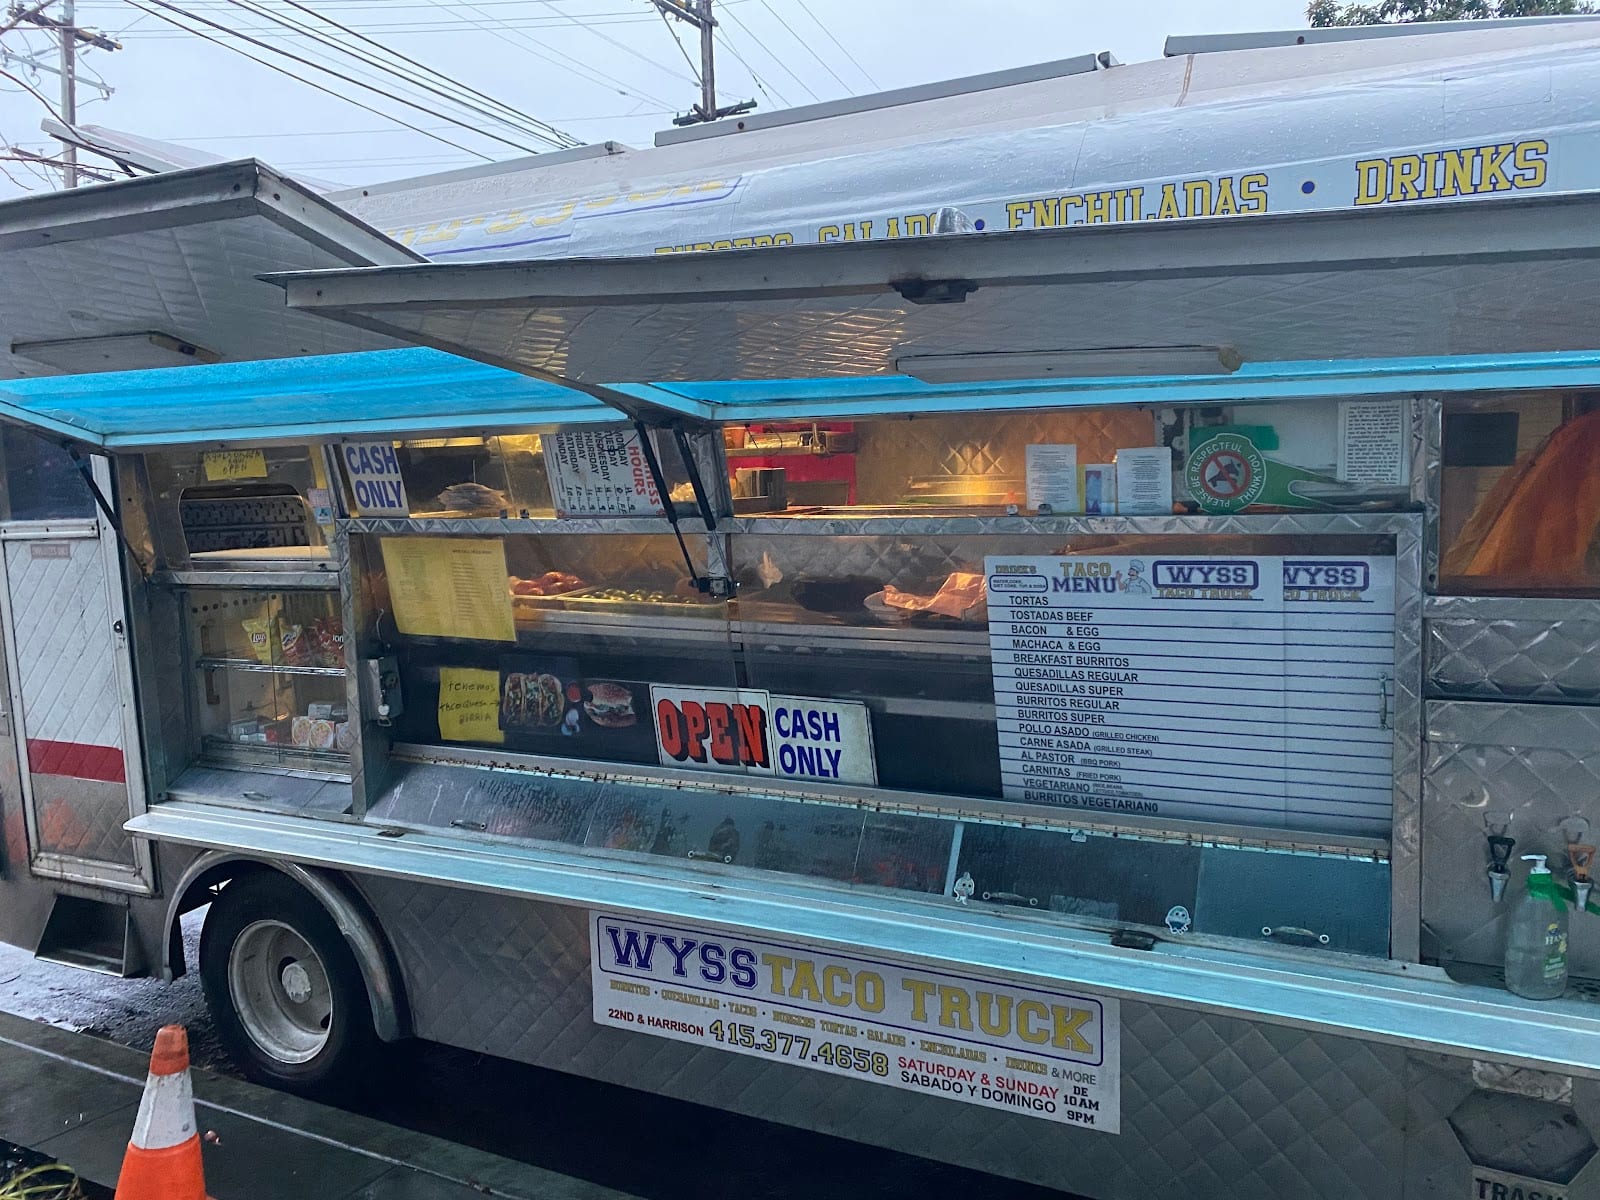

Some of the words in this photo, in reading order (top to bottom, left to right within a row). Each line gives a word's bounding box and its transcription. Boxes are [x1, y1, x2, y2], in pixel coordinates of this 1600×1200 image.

[1006, 173, 1268, 228] ENCHILADAS
[1355, 140, 1549, 206] DRINKS
[345, 446, 399, 475] CASH
[1191, 441, 1242, 473] RESPECTFUL
[1248, 454, 1261, 474] YOU
[628, 446, 646, 496] HOURS
[1191, 475, 1201, 487] BE
[1238, 475, 1262, 504] THANK
[355, 479, 403, 508] ONLY
[1195, 488, 1230, 507] PLEASE
[1060, 562, 1112, 577] TACO
[1166, 566, 1248, 584] WYSS
[1052, 576, 1118, 593] MENU
[1200, 588, 1253, 599] TRUCK
[1009, 595, 1049, 606] TORTAS
[1010, 610, 1063, 621] TOSTADAS
[1066, 611, 1094, 622] BEEF
[1011, 625, 1047, 635] BACON
[1066, 627, 1073, 636] &
[1076, 626, 1099, 637] EGG
[1012, 639, 1063, 650] MACHACA
[1068, 641, 1075, 650] &
[1078, 641, 1101, 651] EGG
[1013, 653, 1073, 665] BREAKFAST
[1076, 656, 1129, 667] BURRITOS
[1014, 667, 1085, 680] QUESADILLAS
[1087, 671, 1138, 682] REGULAR
[1015, 682, 1086, 694] QUESADILLAS
[1088, 685, 1124, 696] SUPER
[1016, 696, 1067, 707] BURRITOS
[1070, 699, 1120, 711] REGULAR
[775, 707, 841, 743] CASH
[1017, 709, 1068, 721] BURRITOS
[1070, 712, 1105, 724] SUPER
[657, 699, 770, 768] OPEN
[1019, 723, 1052, 734] POLLO
[1054, 725, 1090, 737] ASADO
[1092, 731, 1124, 740] (GRILLED
[1125, 733, 1160, 742] CHICKEN)
[1020, 737, 1054, 748] CARNE
[1056, 739, 1091, 751] ASADA
[1093, 745, 1125, 754] (GRILLED
[1127, 747, 1153, 757] STEAK)
[779, 743, 842, 778] ONLY
[1021, 751, 1034, 760] AL
[1037, 752, 1075, 764] PASTOR
[1099, 759, 1121, 768] PORK)
[1022, 764, 1071, 777] CARNITAS
[1099, 773, 1122, 783] PORK)
[1023, 778, 1090, 792] VEGETARIANO
[1024, 791, 1079, 805] BURRITOS
[605, 925, 758, 990] WYSS
[762, 952, 885, 1014] TACO
[902, 978, 1094, 1054] TRUCK
[608, 1008, 634, 1023] 22ND
[637, 1014, 645, 1025] &
[647, 1016, 704, 1037] HARRISON
[709, 1019, 889, 1077] 415.377.4658
[898, 1056, 976, 1083] SATURDAY
[980, 1073, 991, 1086] &
[995, 1076, 1059, 1101] SUNDAY
[1051, 1066, 1060, 1078] &
[1062, 1069, 1097, 1085] MORE
[901, 1071, 963, 1094] SABADO
[967, 1084, 978, 1097] Y
[981, 1090, 1057, 1114] DOMINGO
[1073, 1086, 1088, 1098] DE
[1066, 1110, 1095, 1126] 9PM
